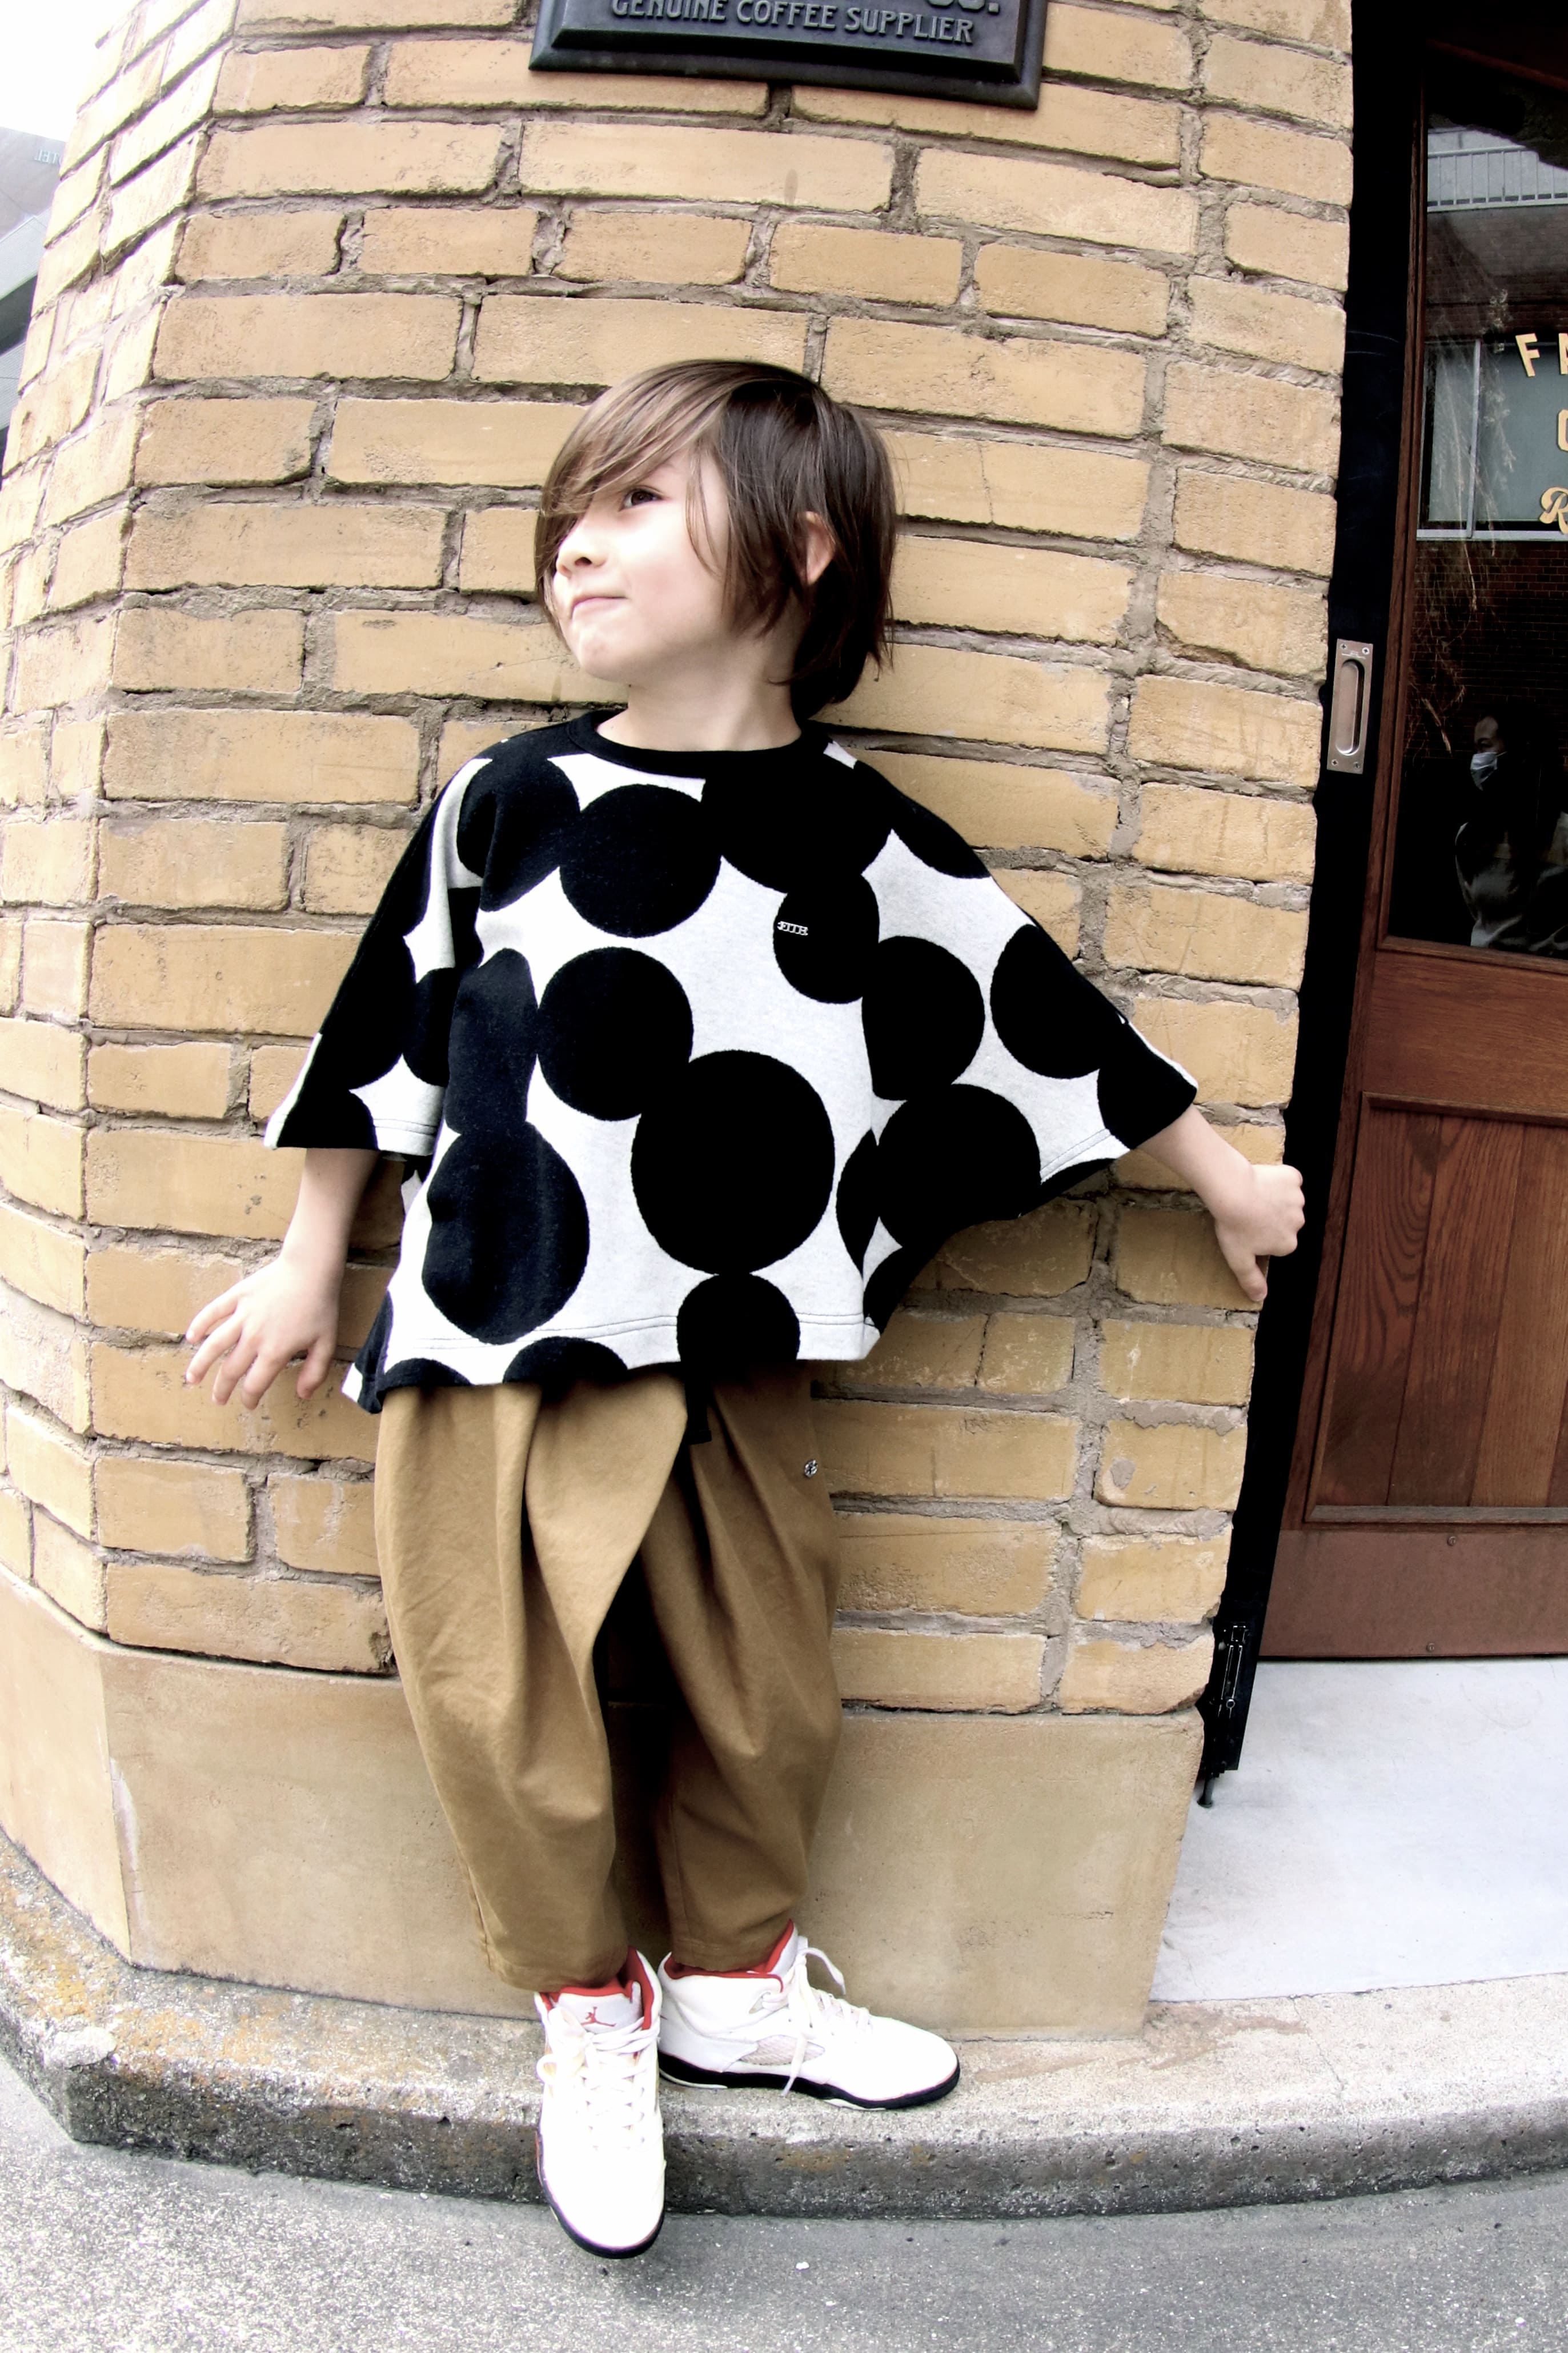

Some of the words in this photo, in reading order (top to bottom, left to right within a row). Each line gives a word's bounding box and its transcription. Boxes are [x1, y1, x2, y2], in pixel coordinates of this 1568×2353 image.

[612, 0, 727, 21] GENUINE
[736, 0, 837, 29] COFFEE
[844, 7, 974, 44] SUPPLIER
